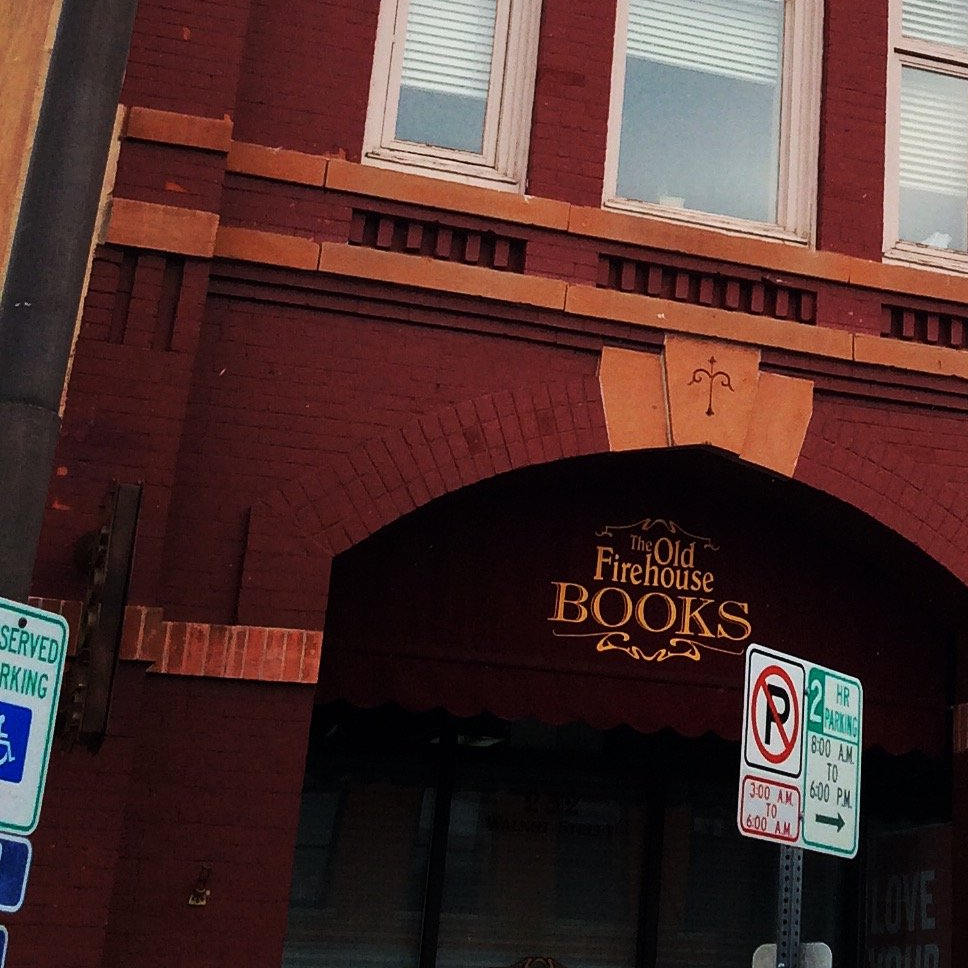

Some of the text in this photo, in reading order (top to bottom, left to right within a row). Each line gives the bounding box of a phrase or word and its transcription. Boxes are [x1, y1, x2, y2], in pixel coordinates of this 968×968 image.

[629, 534, 696, 569] The Old
[593, 545, 714, 593] Firehouse
[547, 581, 752, 641] BOOKS
[809, 679, 823, 723] 2
[836, 684, 850, 708] HR
[824, 707, 858, 738] PARKING
[811, 735, 855, 764] 8:00 A.M.
[826, 762, 839, 783] TO
[749, 782, 770, 801] 3:00
[809, 780, 853, 809] 6:00 P.M.
[746, 813, 767, 831] 6:00
[766, 802, 778, 819] TO
[870, 869, 936, 936] LOVE
